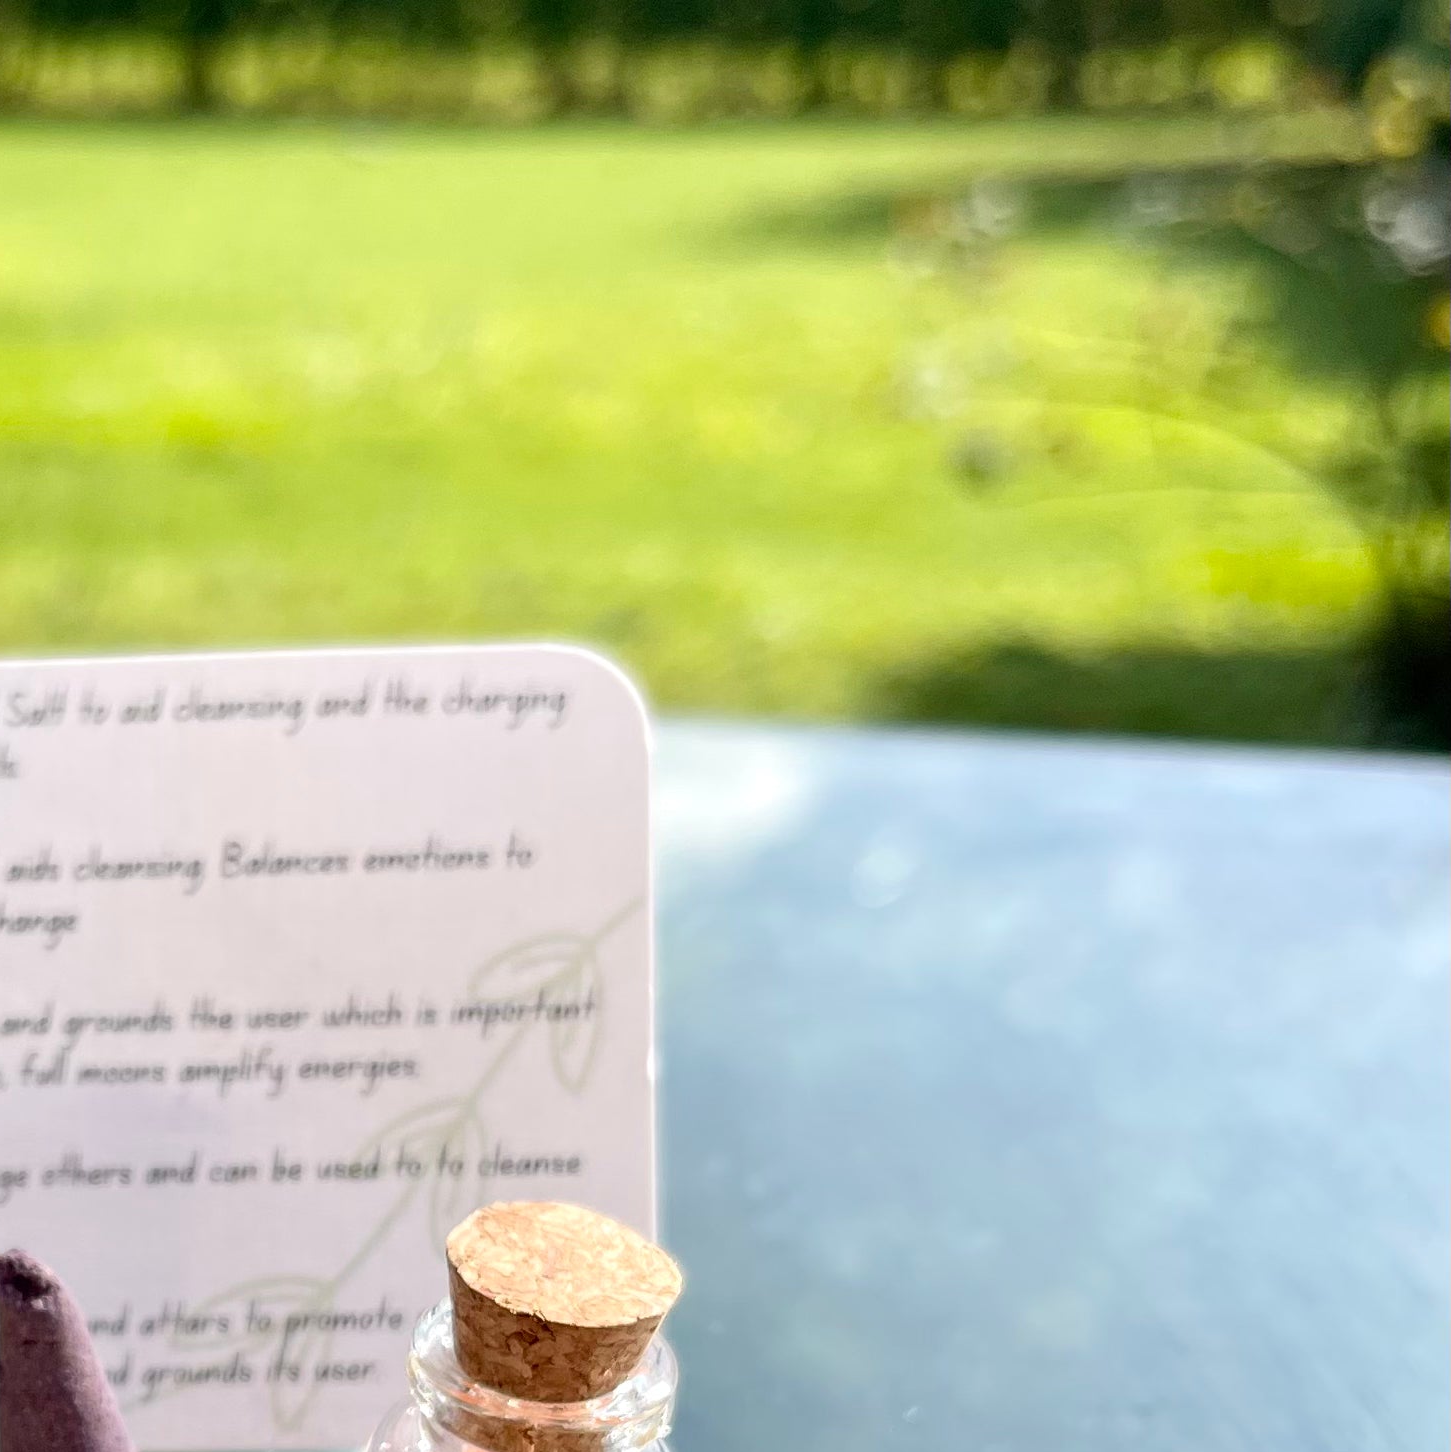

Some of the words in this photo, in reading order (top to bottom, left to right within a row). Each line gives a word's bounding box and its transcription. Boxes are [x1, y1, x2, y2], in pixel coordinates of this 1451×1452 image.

[5, 690, 67, 728] Salt
[79, 686, 109, 725] to
[120, 686, 161, 723] aid
[174, 682, 305, 734] cleansing
[317, 677, 371, 717] and
[384, 674, 430, 713] the
[5, 840, 58, 882] aids
[75, 842, 205, 896] cleansing
[220, 838, 350, 880] Balances
[363, 835, 488, 874] emotions
[502, 832, 534, 870] to
[0, 1000, 53, 1034] and
[63, 998, 174, 1051] grounds
[190, 992, 233, 1032] the
[249, 1008, 310, 1028] user
[322, 993, 402, 1026] which
[415, 998, 437, 1024] is
[451, 987, 596, 1040] important
[22, 1050, 67, 1085] full
[78, 1065, 166, 1085] moons
[179, 1047, 284, 1099] amplify
[42, 1149, 132, 1186] others
[147, 1146, 197, 1183] and
[209, 1163, 257, 1181] can
[272, 1145, 302, 1182] be
[317, 1145, 381, 1182] used
[395, 1148, 424, 1178] to
[436, 1142, 465, 1177] to
[478, 1139, 582, 1176] cleanse
[86, 1303, 131, 1337] nd
[246, 1301, 274, 1332] to
[286, 1293, 404, 1349] promote
[141, 1350, 251, 1402] grounds
